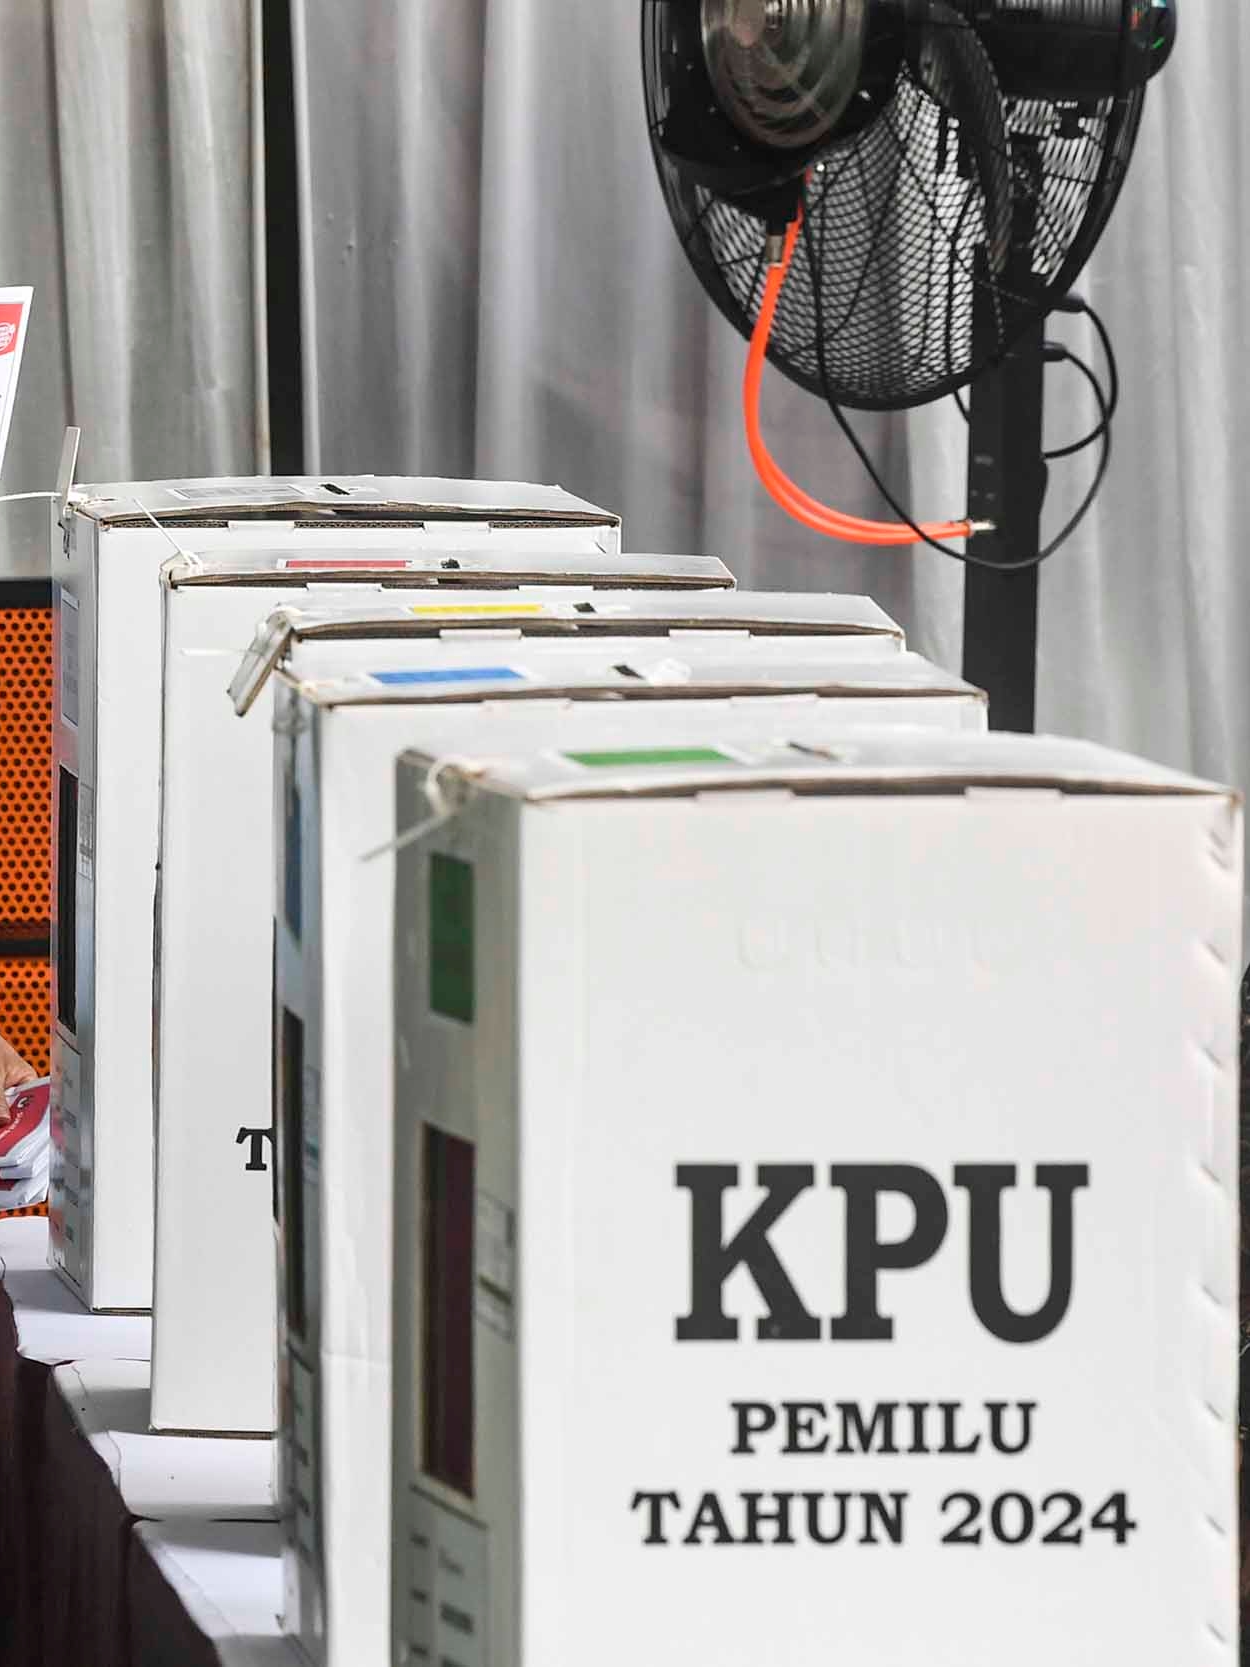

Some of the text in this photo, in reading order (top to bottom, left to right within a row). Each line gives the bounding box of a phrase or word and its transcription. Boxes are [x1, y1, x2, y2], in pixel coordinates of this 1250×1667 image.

[676, 1164, 1089, 1343] KPU
[731, 1402, 1036, 1454] PEMILU
[632, 1492, 1136, 1544] TAHUN 2024
